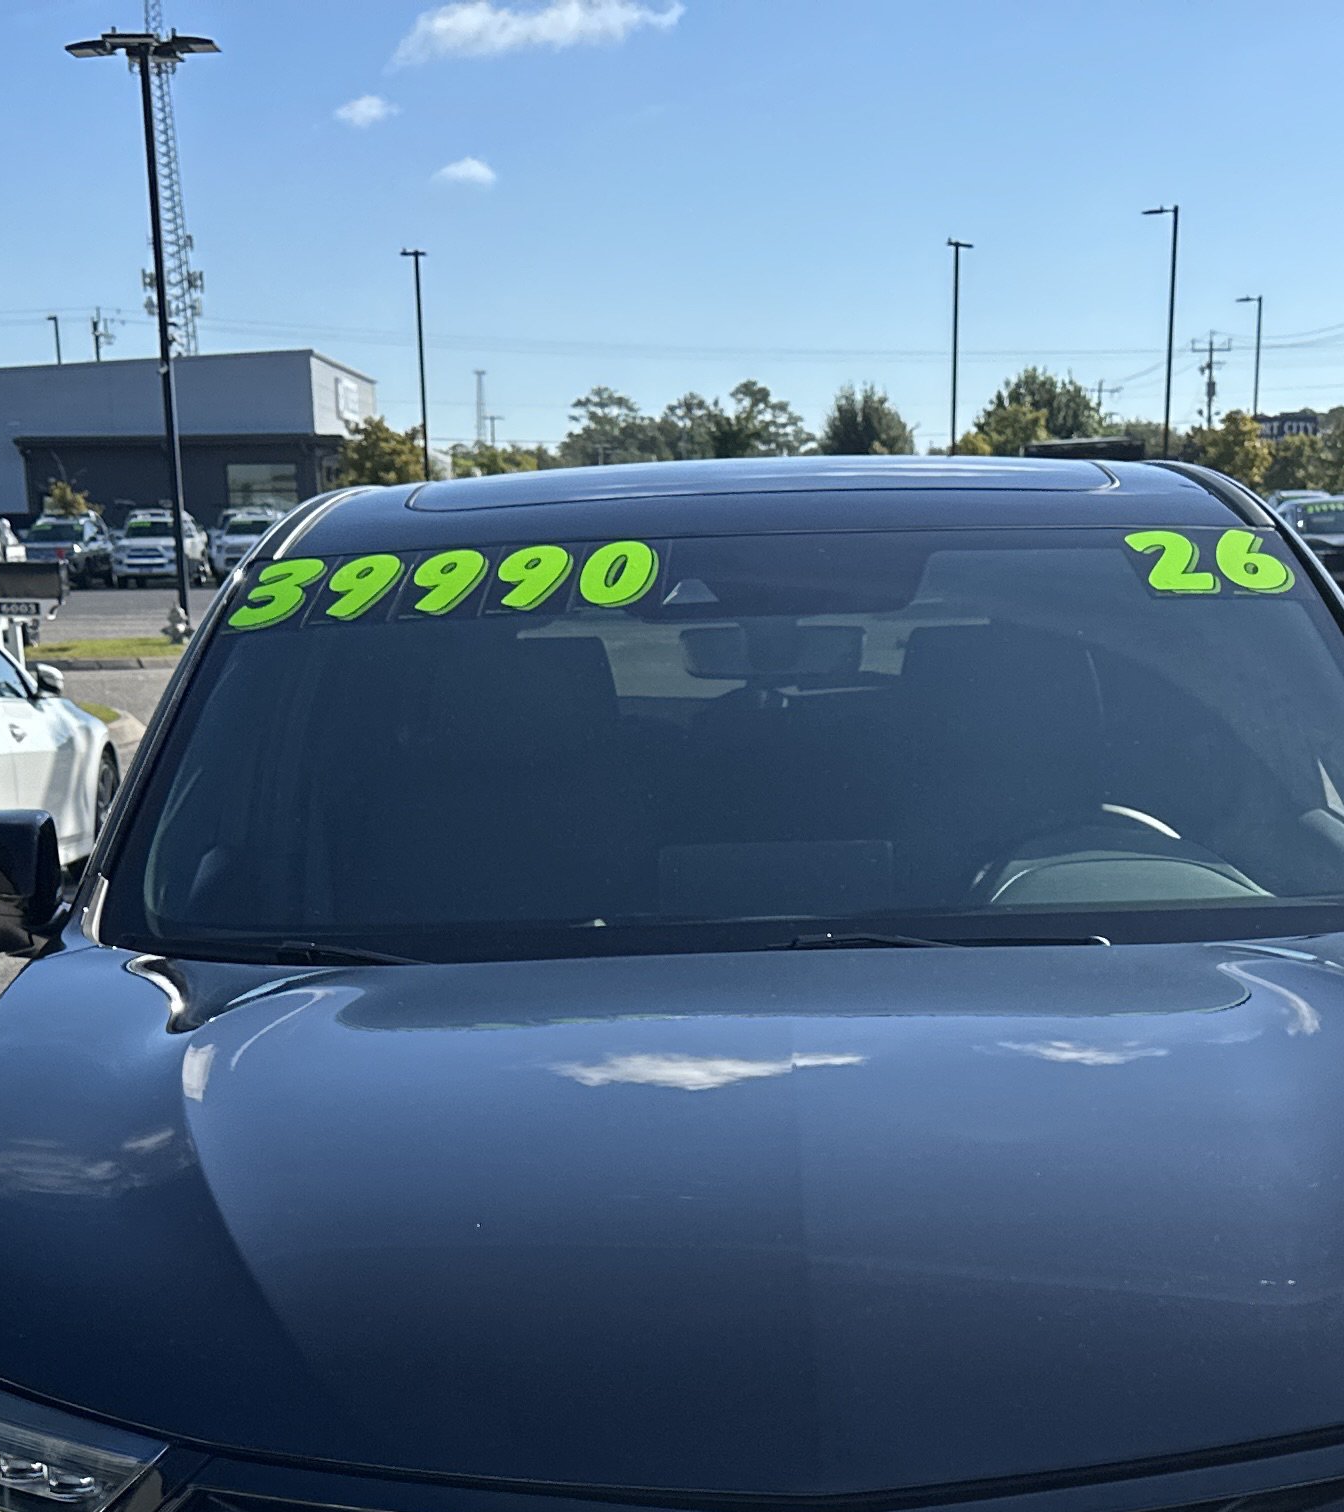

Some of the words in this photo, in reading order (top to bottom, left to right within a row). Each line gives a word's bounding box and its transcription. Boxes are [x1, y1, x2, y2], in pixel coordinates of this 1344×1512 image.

[1283, 421, 1315, 434] CITY
[227, 540, 659, 631] 39990
[1124, 529, 1296, 594] 26
